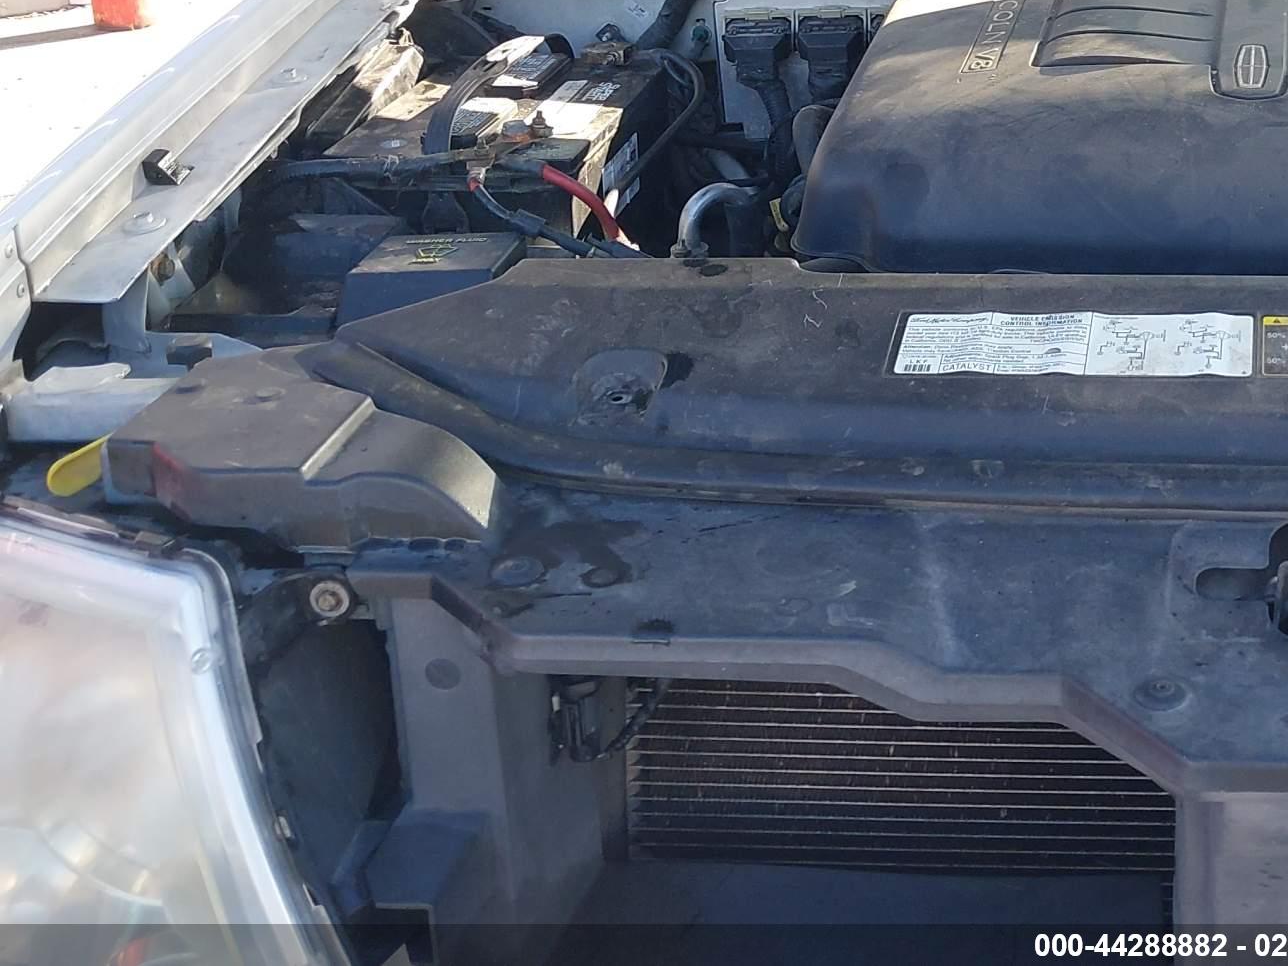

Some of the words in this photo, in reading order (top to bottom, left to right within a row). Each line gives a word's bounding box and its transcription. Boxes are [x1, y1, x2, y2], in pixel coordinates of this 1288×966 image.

[982, 0, 1019, 44] COLN
[968, 47, 999, 71] V8
[1035, 318, 1083, 326] INFORMATION
[942, 362, 992, 372] CATALYST
